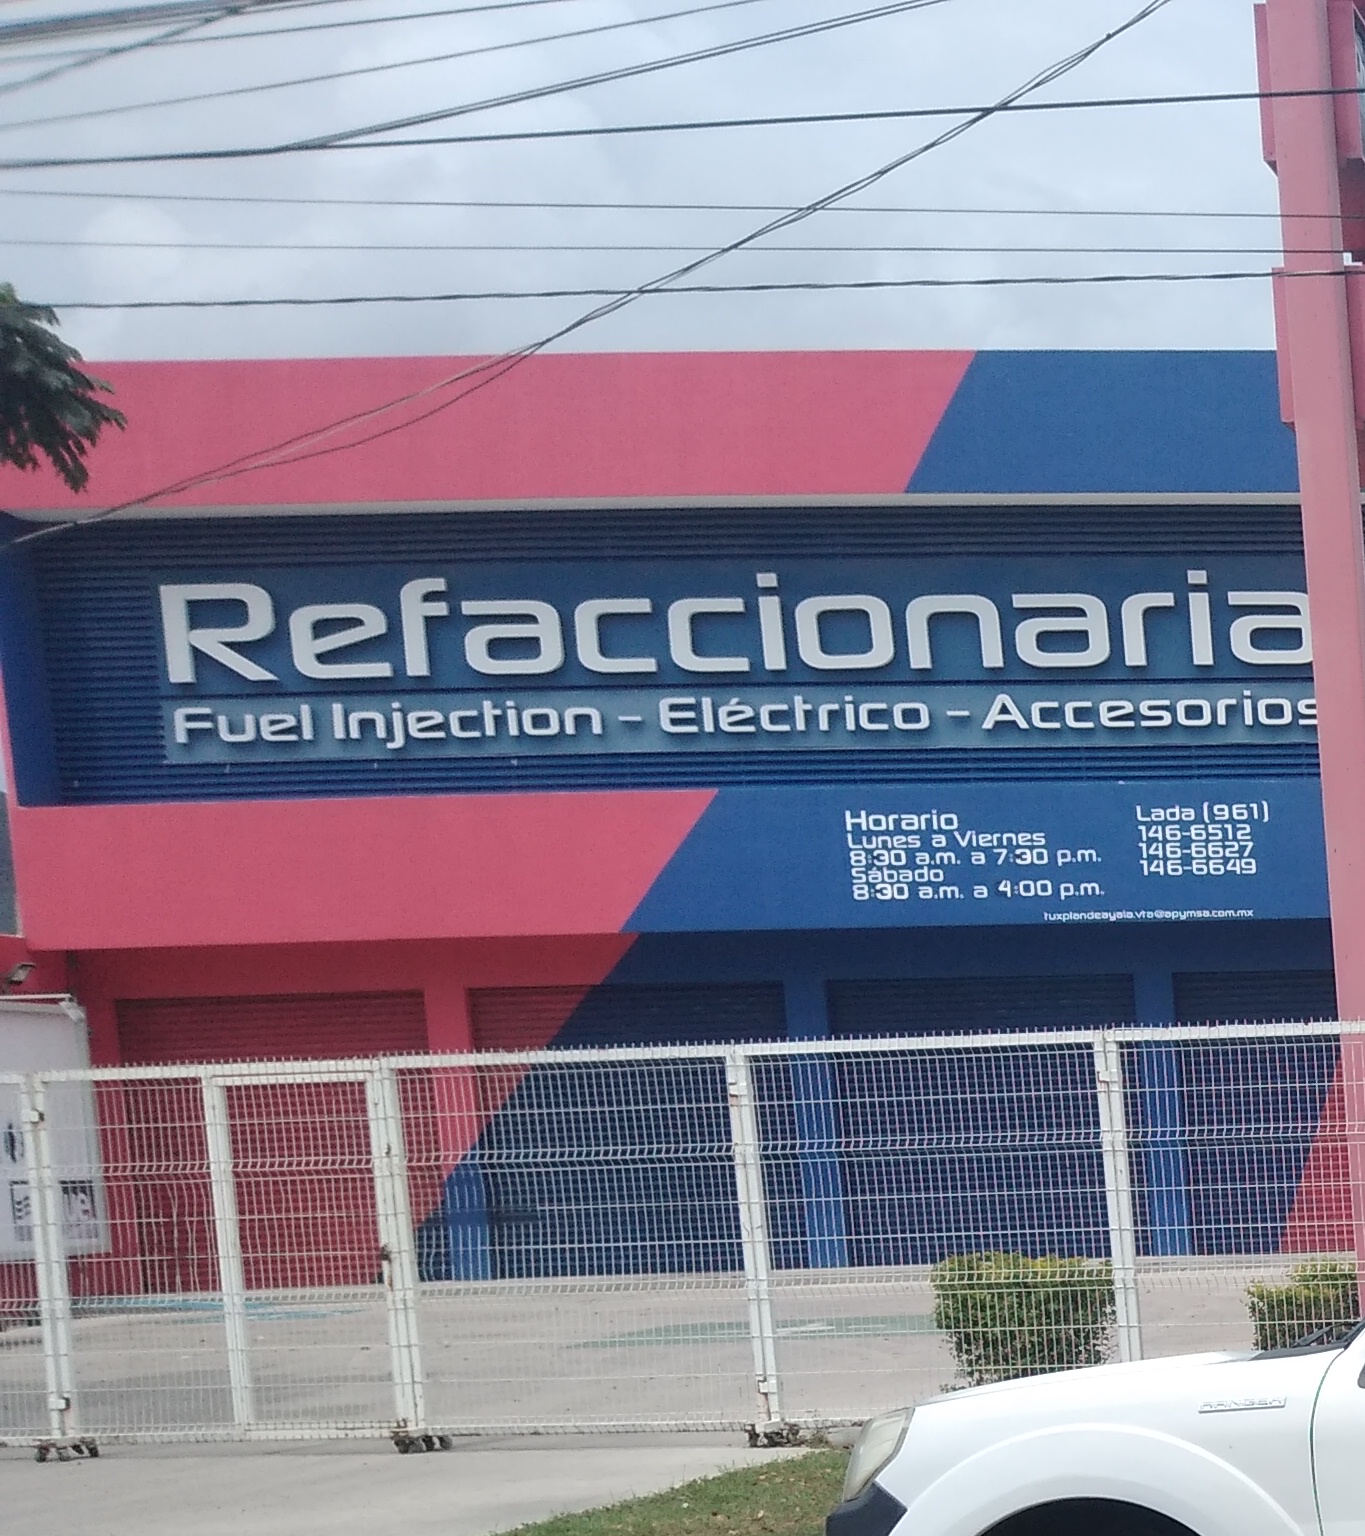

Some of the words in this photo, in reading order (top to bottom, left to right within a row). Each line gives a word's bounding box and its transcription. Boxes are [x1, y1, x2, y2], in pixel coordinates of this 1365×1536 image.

[159, 570, 1313, 683] Refaccionaria
[174, 705, 313, 744] Fuel
[333, 700, 602, 750] Injection
[659, 695, 930, 733] Eléctrico
[1136, 805, 1195, 821] Lada
[1203, 800, 1269, 822] (961)
[845, 810, 959, 831] Horario
[847, 833, 921, 849] Lunes
[932, 834, 946, 847] a
[954, 831, 1046, 847] Viernes
[1138, 824, 1251, 841] 146-6512
[850, 850, 906, 866] 8:30
[915, 852, 961, 866] a.m.
[971, 852, 986, 865] a
[993, 849, 1048, 865] 7:30
[1057, 850, 1102, 867] p.m.
[1138, 841, 1254, 859] 146-6627
[851, 866, 944, 884] Sábado
[1140, 858, 1257, 875] 146-6649
[852, 884, 909, 901] 8:30
[918, 885, 964, 900] a.m.
[973, 884, 988, 898] a
[998, 880, 1052, 897] 4:00
[1060, 881, 1105, 900] p.m.
